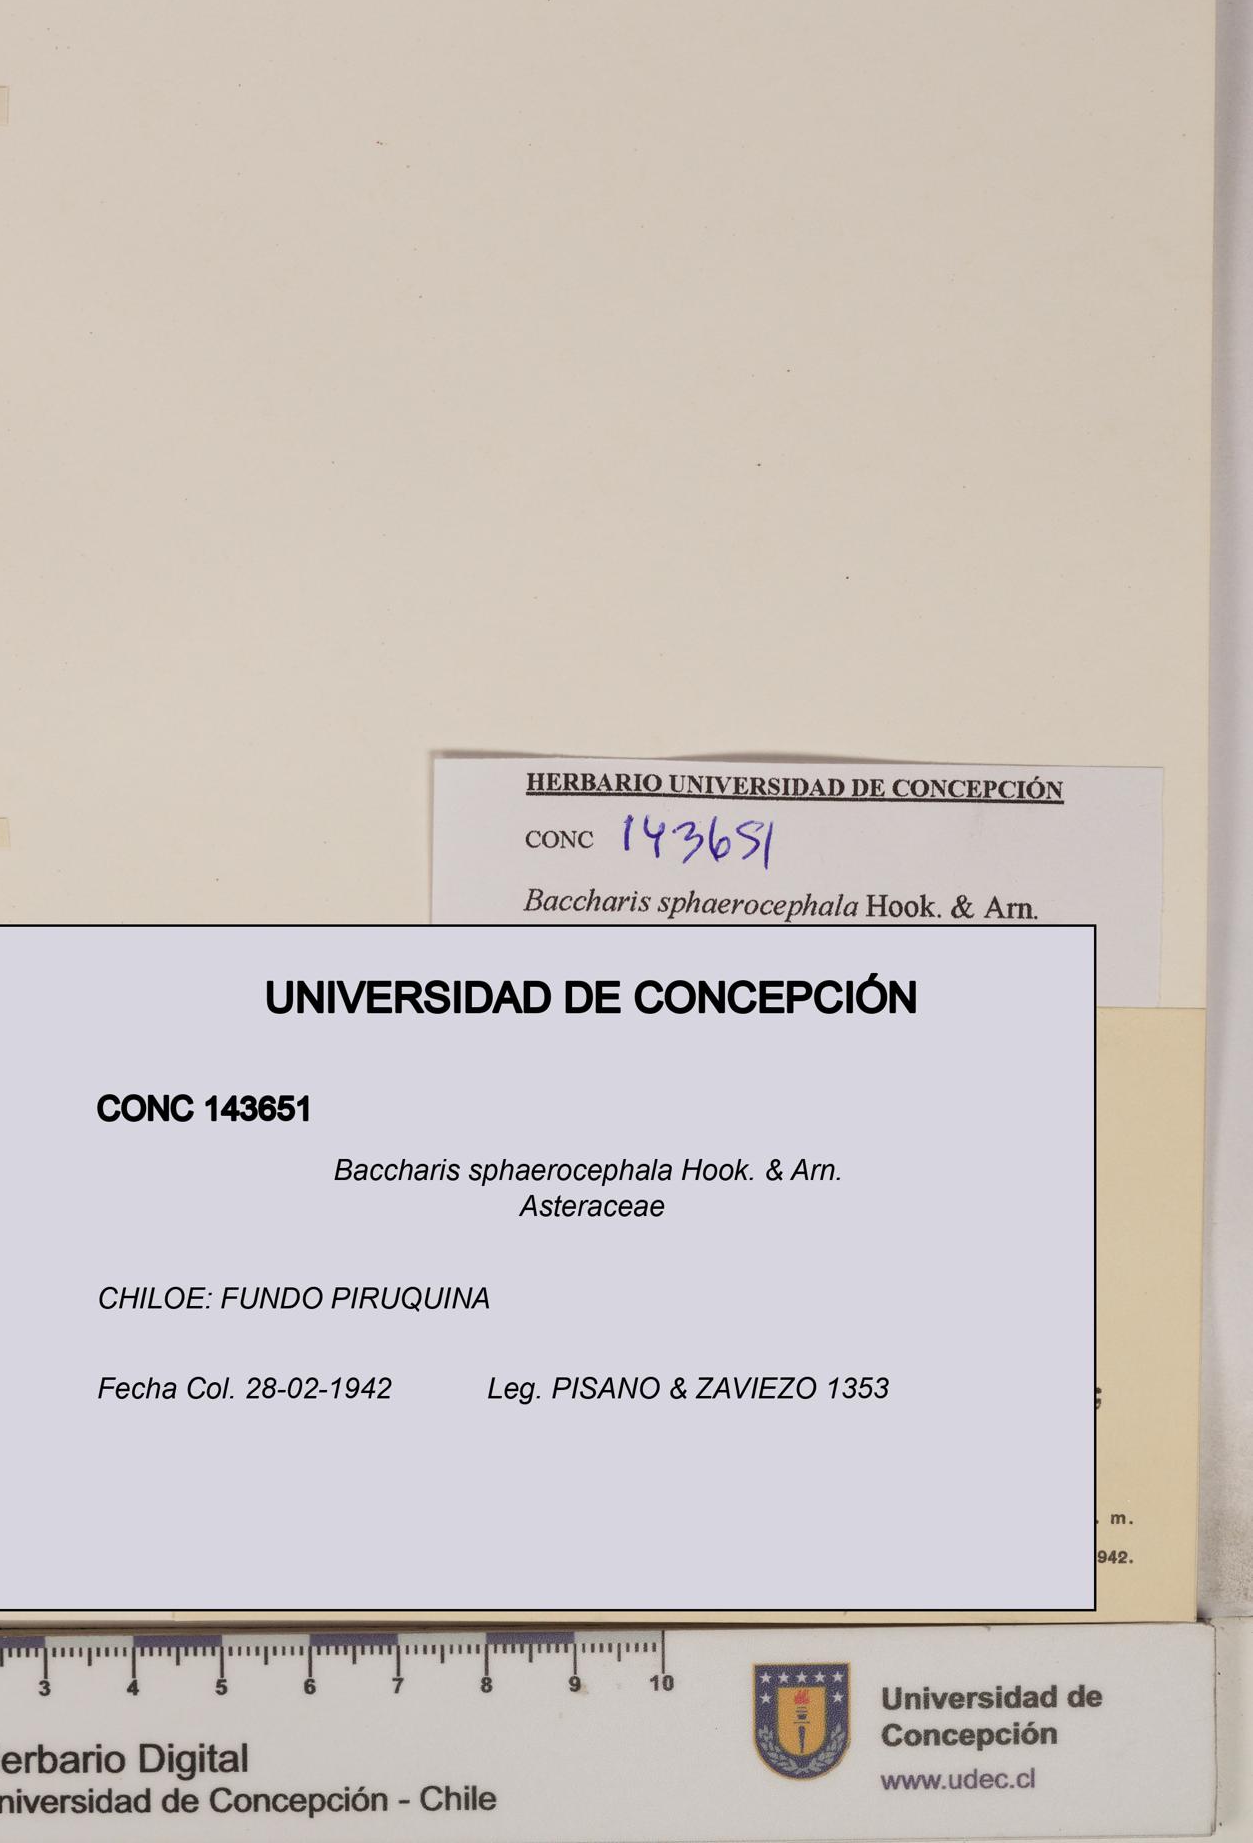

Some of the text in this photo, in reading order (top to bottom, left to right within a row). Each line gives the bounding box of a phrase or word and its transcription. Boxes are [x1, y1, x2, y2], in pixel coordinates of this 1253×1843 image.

[525, 772, 1064, 802] HERBARIO UNIVERSIDAD DE CONCEPCIÓN
[525, 814, 773, 870] CONC 143651
[522, 887, 1038, 923] Baccharis sphaerocephala Hook. & Arn.
[38, 1677, 52, 1697] 3
[126, 1677, 140, 1696] 4
[215, 1677, 228, 1696] 5
[303, 1678, 317, 1695] 6
[391, 1677, 405, 1694] 7
[480, 1676, 493, 1694] 8
[568, 1675, 582, 1693] 9
[649, 1674, 675, 1692] 10
[882, 1684, 1103, 1711] Universidad de
[880, 1721, 1058, 1752] Concepción
[139, 1742, 248, 1782] Digital
[880, 1767, 1036, 1791] www.udec.cl
[161, 1787, 200, 1814] de
[209, 1785, 389, 1819] Concepción
[419, 1785, 497, 1812] Chile
